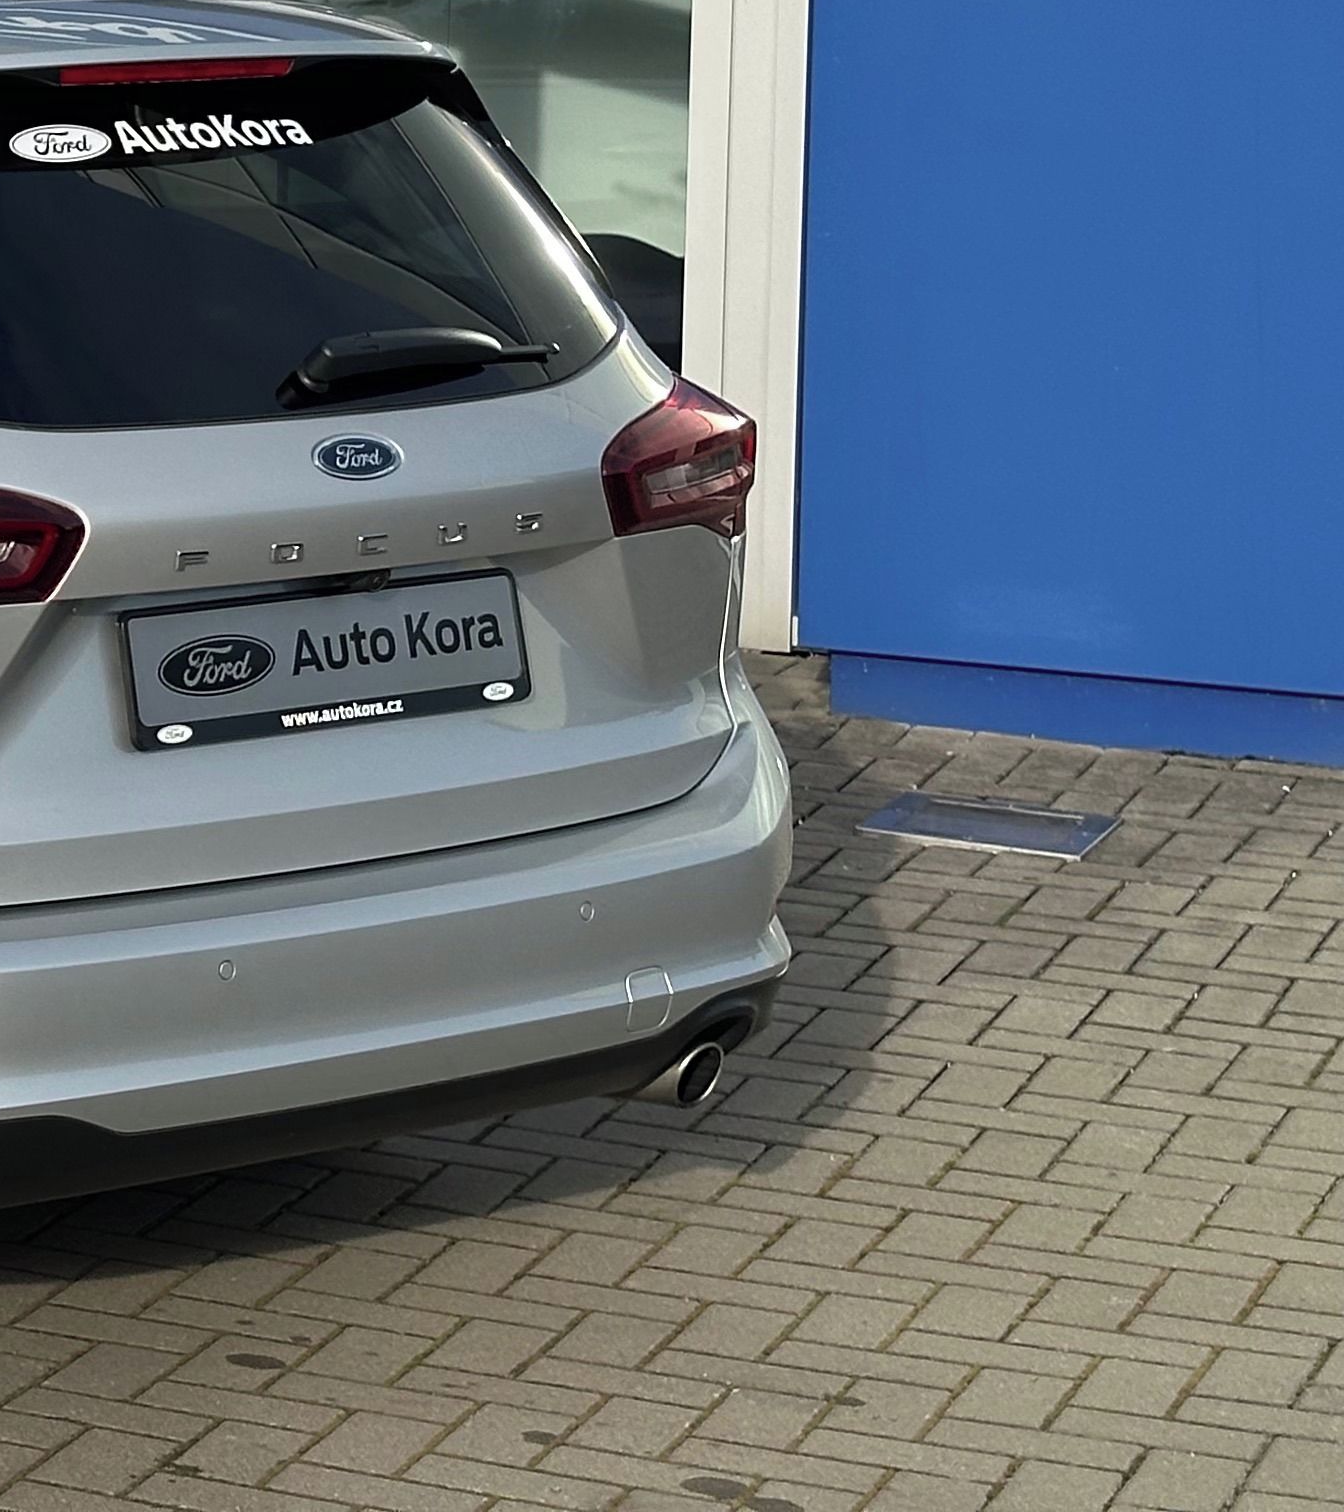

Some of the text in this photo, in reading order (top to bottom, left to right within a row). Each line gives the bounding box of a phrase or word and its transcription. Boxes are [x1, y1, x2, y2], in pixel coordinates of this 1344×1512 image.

[32, 114, 314, 156] Ford AutoKora
[335, 444, 384, 469] Ford
[174, 511, 544, 572] FOCUS
[183, 610, 505, 688] Ford Auto Kora
[280, 698, 405, 730] www.autokora.cz
